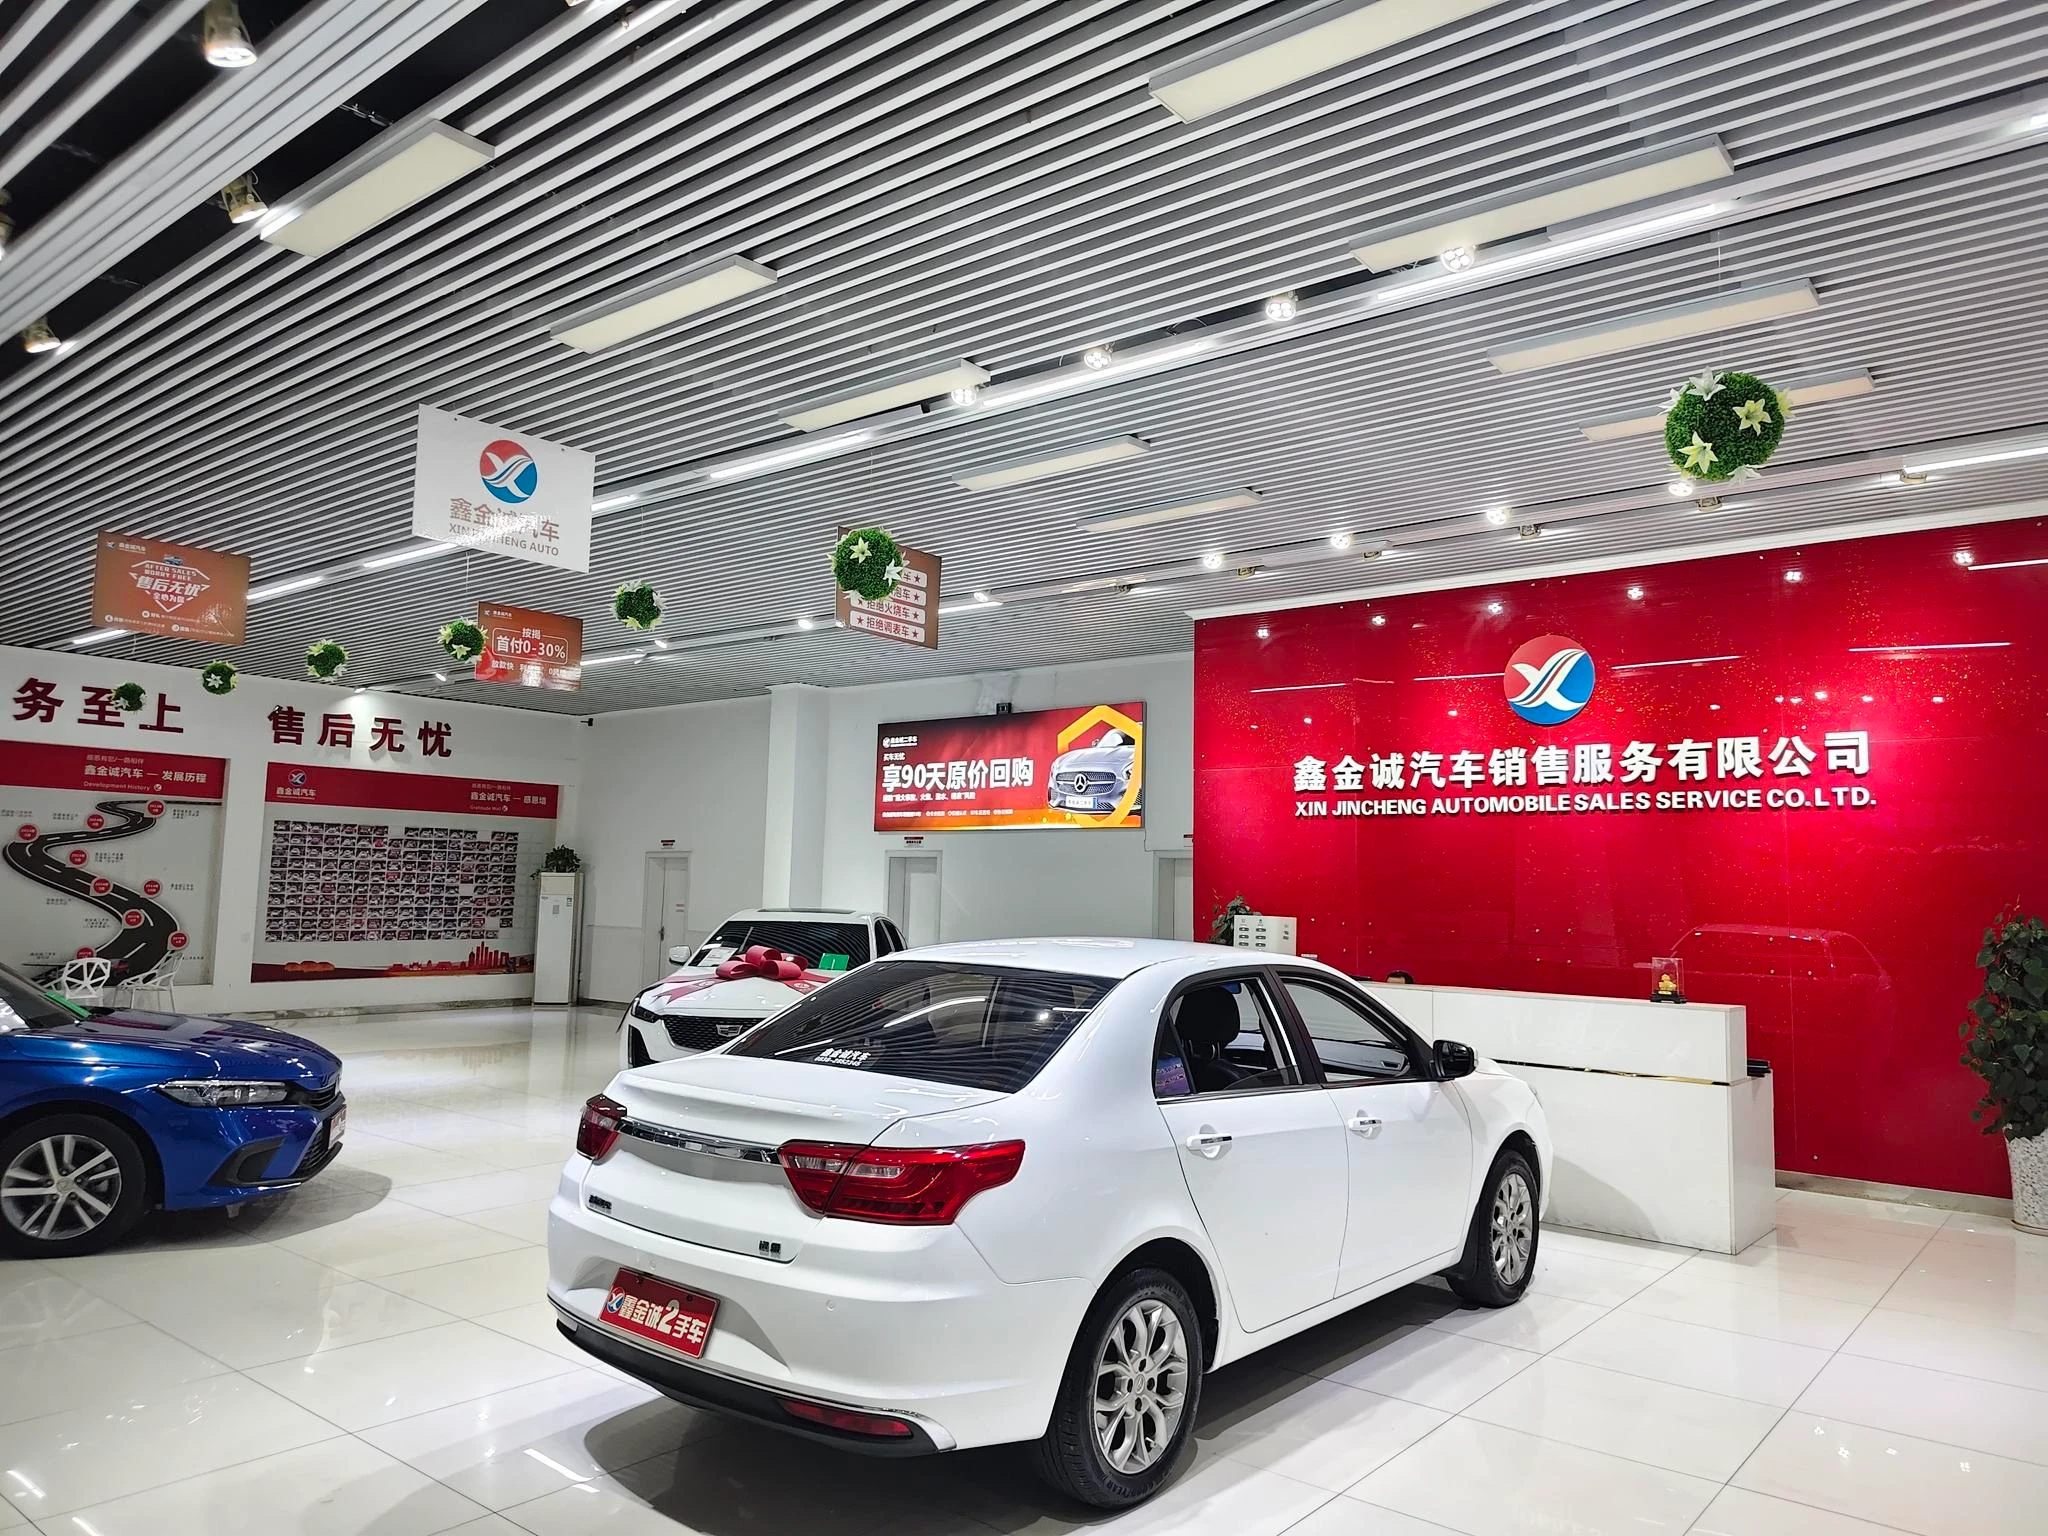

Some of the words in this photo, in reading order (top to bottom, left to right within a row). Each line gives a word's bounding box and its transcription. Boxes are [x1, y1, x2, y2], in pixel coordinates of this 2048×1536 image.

[449, 498, 560, 542] 鑫金车
[529, 541, 560, 556] AUTO
[144, 563, 171, 572] AFTER
[172, 567, 197, 577] SALES
[144, 569, 170, 578] WORRY
[172, 574, 192, 582] FREE
[136, 577, 202, 597] 售后无忧
[522, 627, 541, 640] 按揭
[496, 635, 566, 659] 首付0-30%
[268, 704, 454, 759] 售后无忧
[1293, 730, 1870, 792] 鑫金诚汽车销售服务有限公司
[162, 769, 207, 783] 发展历程
[882, 756, 1035, 793] 享90天原价回购
[83, 781, 127, 790] Development
[127, 783, 151, 792] History
[1294, 800, 1327, 816] XIN
[1331, 798, 1427, 816] JINCHENG
[1430, 795, 1571, 814] AUTOMOBILE
[1573, 791, 1652, 811] SALES
[1655, 789, 1765, 809] SERVICE
[618, 1294, 707, 1344] 鑫金诚2手车
